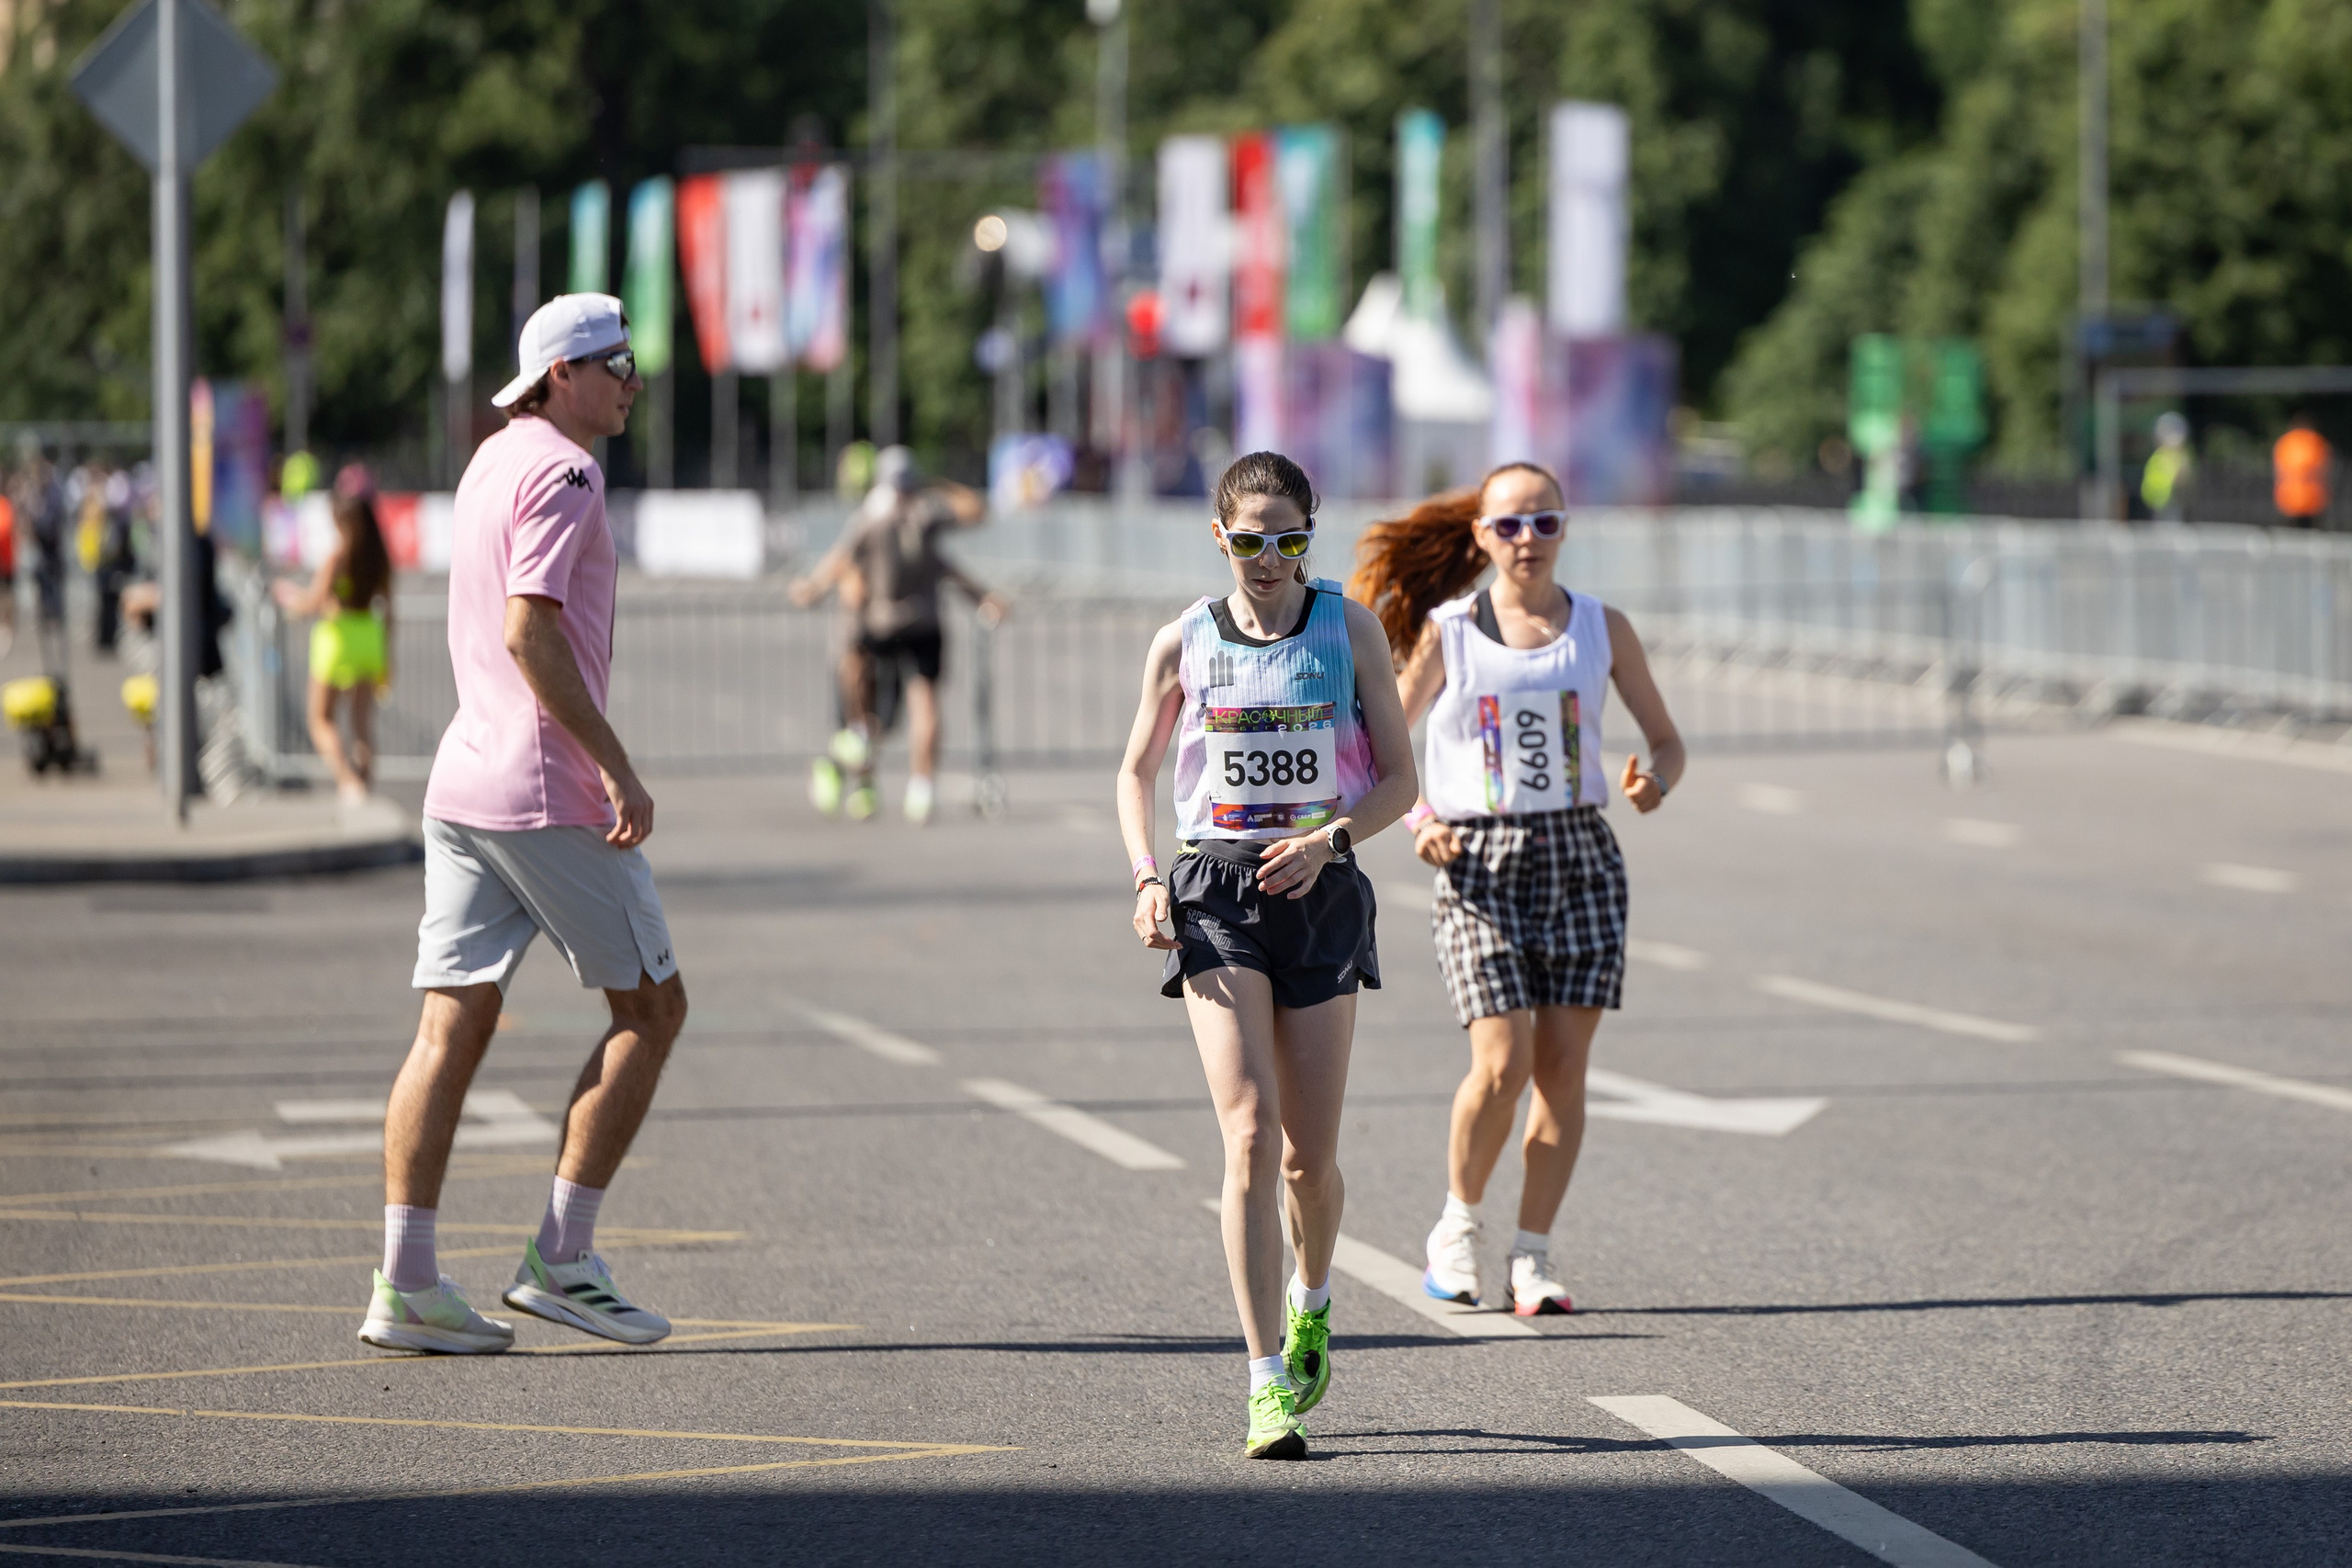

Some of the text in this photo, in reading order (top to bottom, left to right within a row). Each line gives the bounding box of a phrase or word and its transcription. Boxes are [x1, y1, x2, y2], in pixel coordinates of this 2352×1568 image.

[1215, 706, 1324, 724] КРАСОЧНЫЙ
[1277, 720, 1332, 733] 2026
[1517, 709, 1551, 792] 6099
[1224, 748, 1319, 787] 5388
